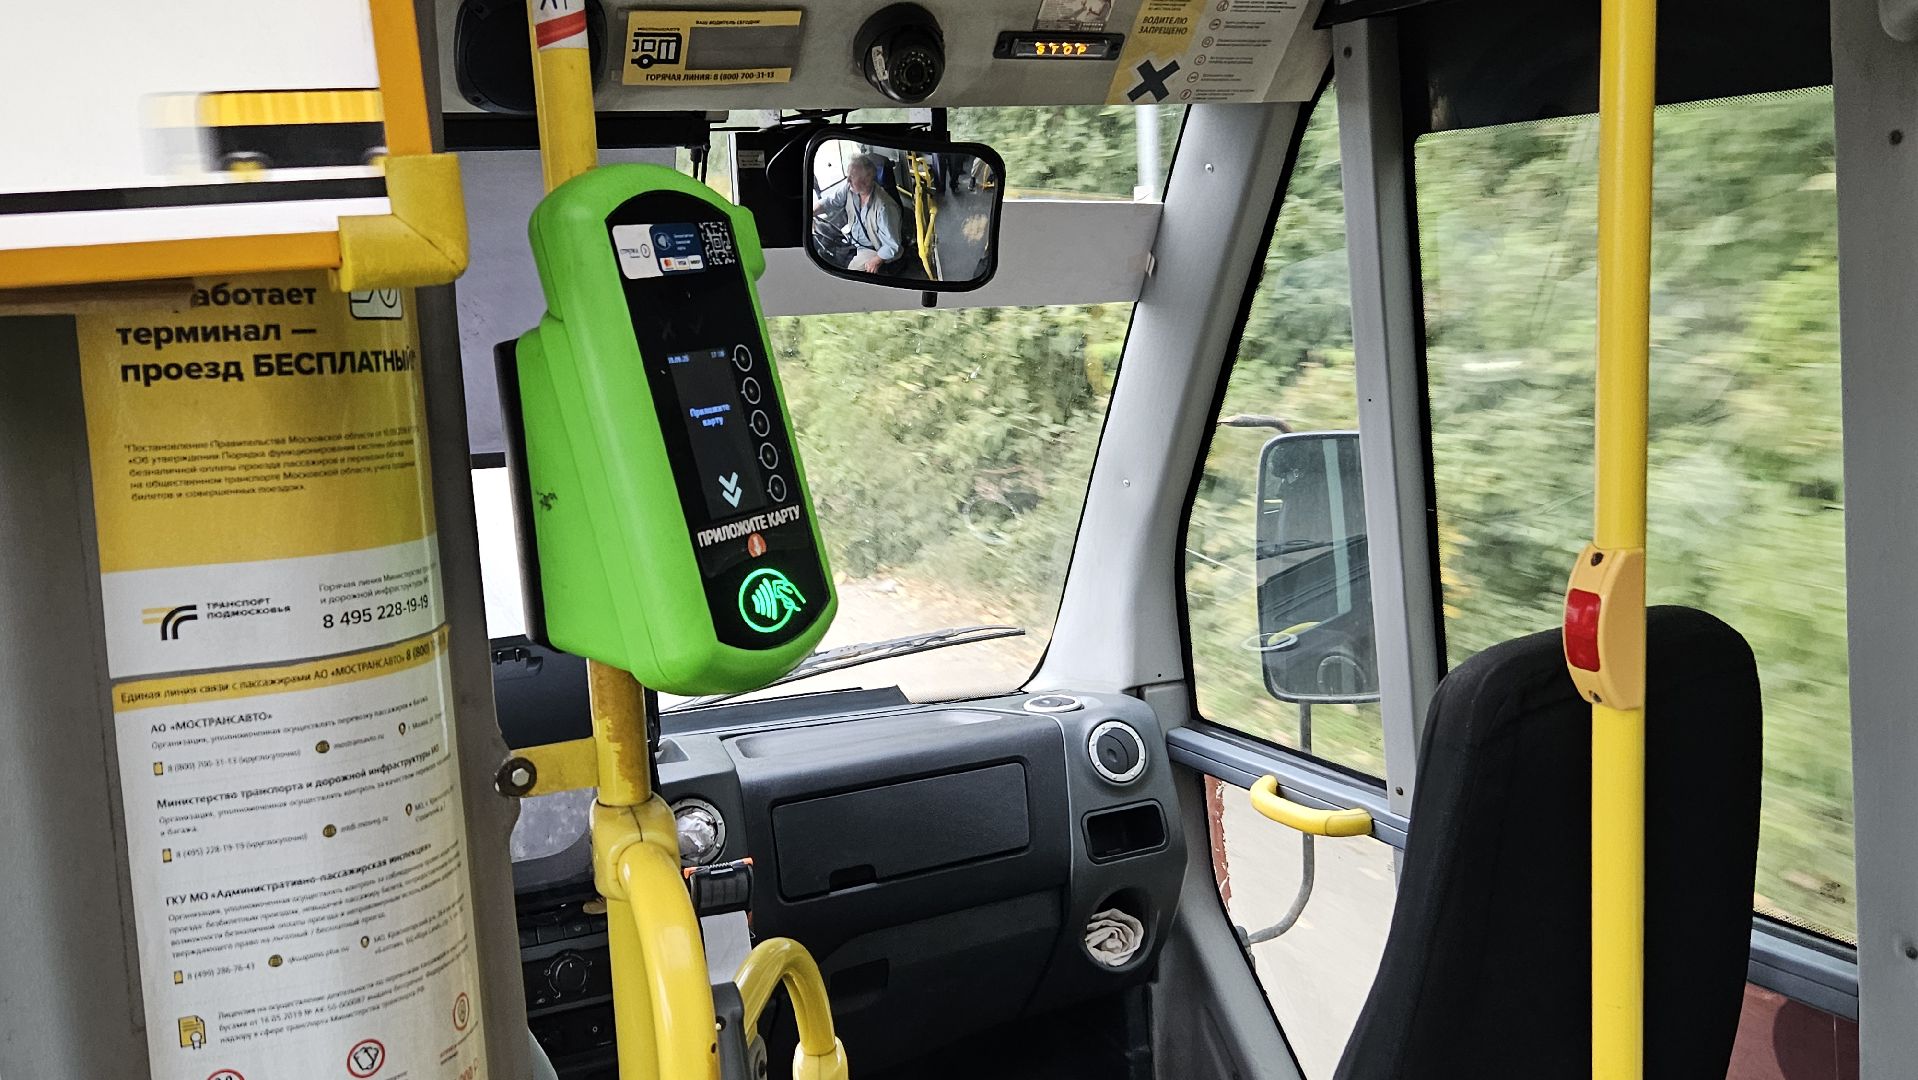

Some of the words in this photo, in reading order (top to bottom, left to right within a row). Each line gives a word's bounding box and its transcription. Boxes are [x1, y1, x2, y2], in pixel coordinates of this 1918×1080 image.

[1142, 16, 1188, 25] ВОДИТЕЛЮ
[1138, 27, 1188, 35] ЗАПРЕЩЕНО
[1035, 42, 1088, 56] STOP
[646, 73, 682, 82] ГОРЯЧАЯ
[683, 73, 713, 81] ЛИНИЯ:
[720, 72, 740, 81] (800)
[189, 282, 317, 307] аботает
[116, 324, 281, 351] терминал
[121, 361, 244, 387] проезд
[690, 404, 731, 418] Приложите
[702, 417, 724, 428] карту
[697, 514, 768, 548] ПРИЛОЖИТЕ
[766, 504, 800, 527] КАРТУ
[319, 581, 356, 593] Горячая
[206, 598, 271, 610] ТРАНСПОРТ
[328, 590, 373, 605] дорожной
[206, 605, 291, 620] ПОДМОСКОВЬЯ
[322, 613, 335, 629] 8
[339, 607, 373, 627] 495
[376, 593, 429, 621] 228-19-19
[120, 691, 161, 704] Единая
[163, 687, 197, 699] линия
[313, 668, 329, 681] АО
[405, 648, 412, 661] 8
[150, 722, 167, 735] АО
[171, 711, 273, 732] «МОСТРАНСАВТО»
[156, 792, 239, 810] Министерство
[241, 781, 304, 799] транспорта
[314, 768, 367, 789] дорожной
[368, 749, 431, 778] инфраструктуры
[165, 894, 187, 908] ГКУ
[189, 891, 209, 902] МО
